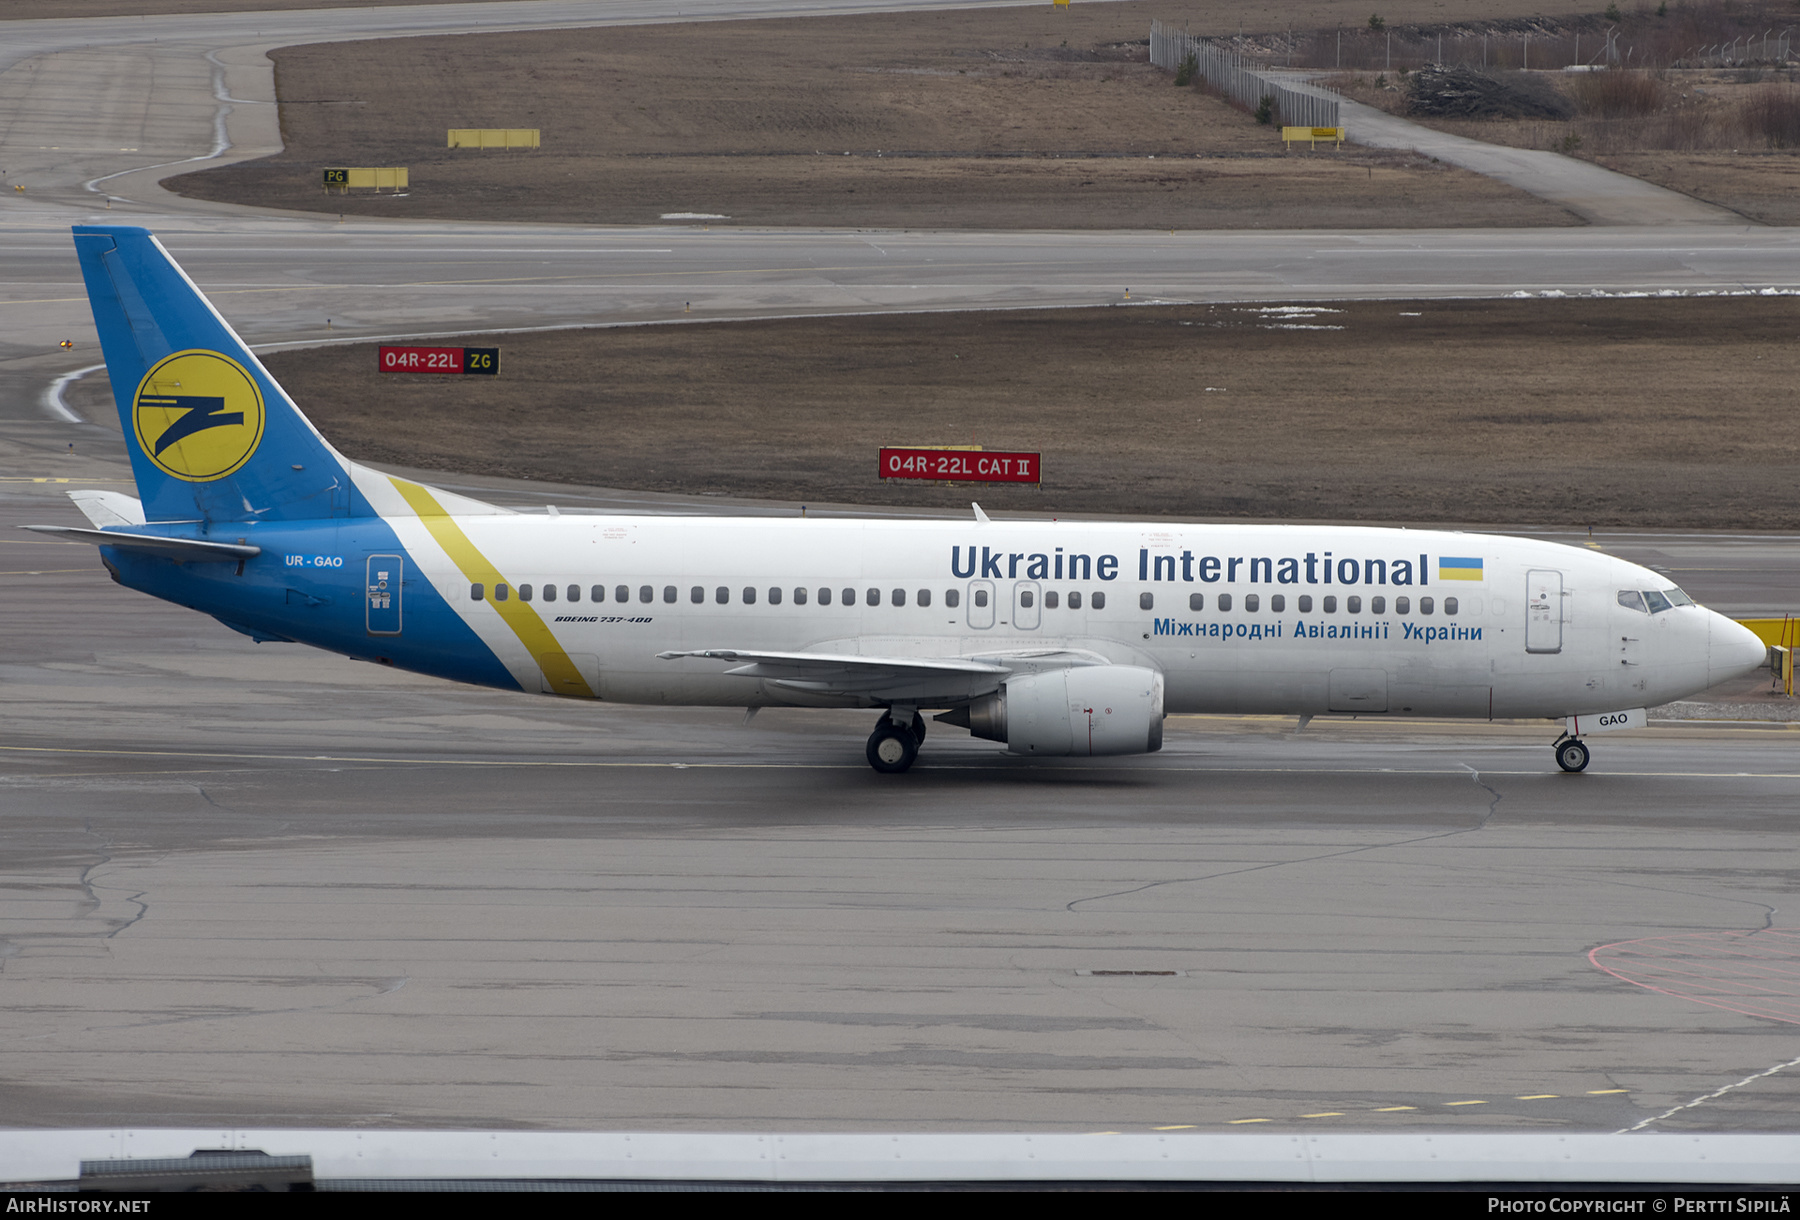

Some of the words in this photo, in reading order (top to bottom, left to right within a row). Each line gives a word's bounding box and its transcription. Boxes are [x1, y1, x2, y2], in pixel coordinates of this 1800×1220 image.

[328, 171, 343, 182] PG
[385, 352, 458, 368] 04R-22L
[470, 354, 491, 368] ZG
[889, 456, 972, 474] 04R-22L
[978, 458, 1012, 475] CAT
[285, 555, 303, 566] UR
[314, 556, 343, 567] GAO
[951, 546, 1119, 580] Ukraine
[1139, 549, 1428, 586] International
[1153, 618, 1282, 641] Міжнародні
[1294, 620, 1389, 640] Авіалінії
[1402, 622, 1482, 644] України
[1599, 713, 1628, 726] GAO
